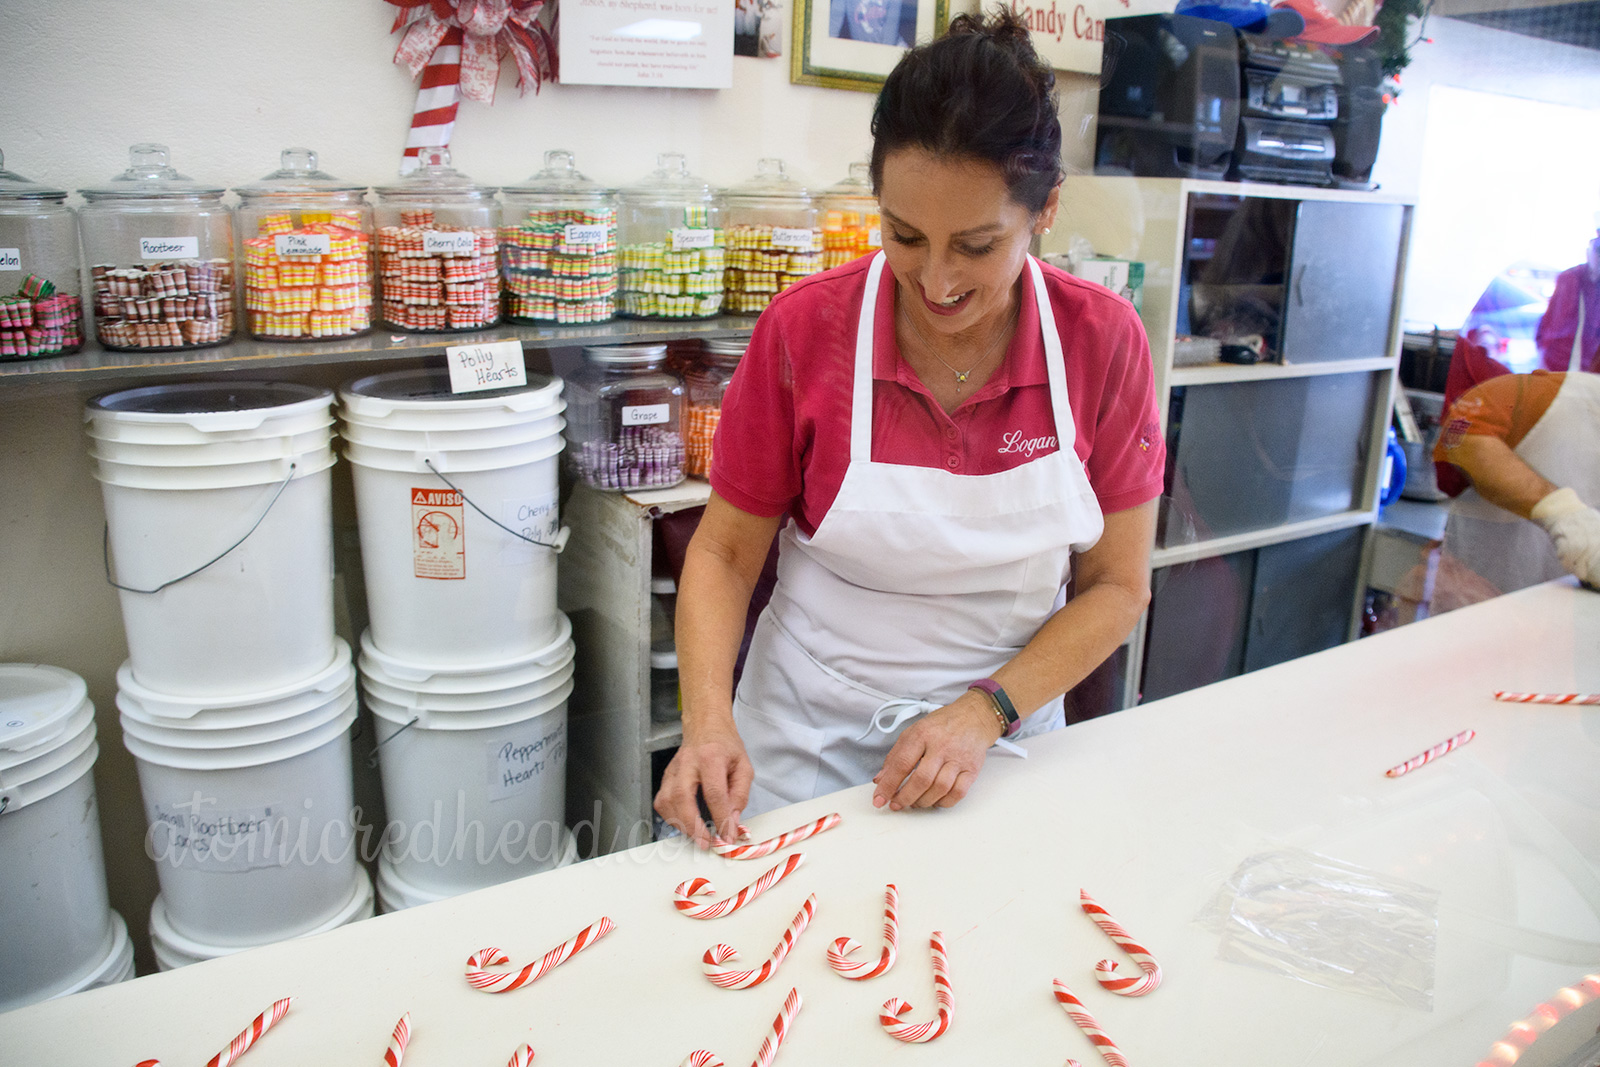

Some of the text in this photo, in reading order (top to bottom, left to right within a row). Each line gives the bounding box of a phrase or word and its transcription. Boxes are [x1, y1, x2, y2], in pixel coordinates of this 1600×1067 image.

[287, 236, 307, 246] Pink
[569, 228, 602, 242] Eggnog
[142, 240, 185, 254] Rootbeer
[280, 246, 323, 255] Lemonade
[427, 237, 472, 250] Cherry Cola
[458, 347, 494, 370] Polly
[475, 363, 519, 385] Hearts
[630, 408, 659, 422] Grape
[998, 430, 1058, 458] Logan
[427, 492, 463, 505] AVISO
[503, 760, 545, 787] Hearts
